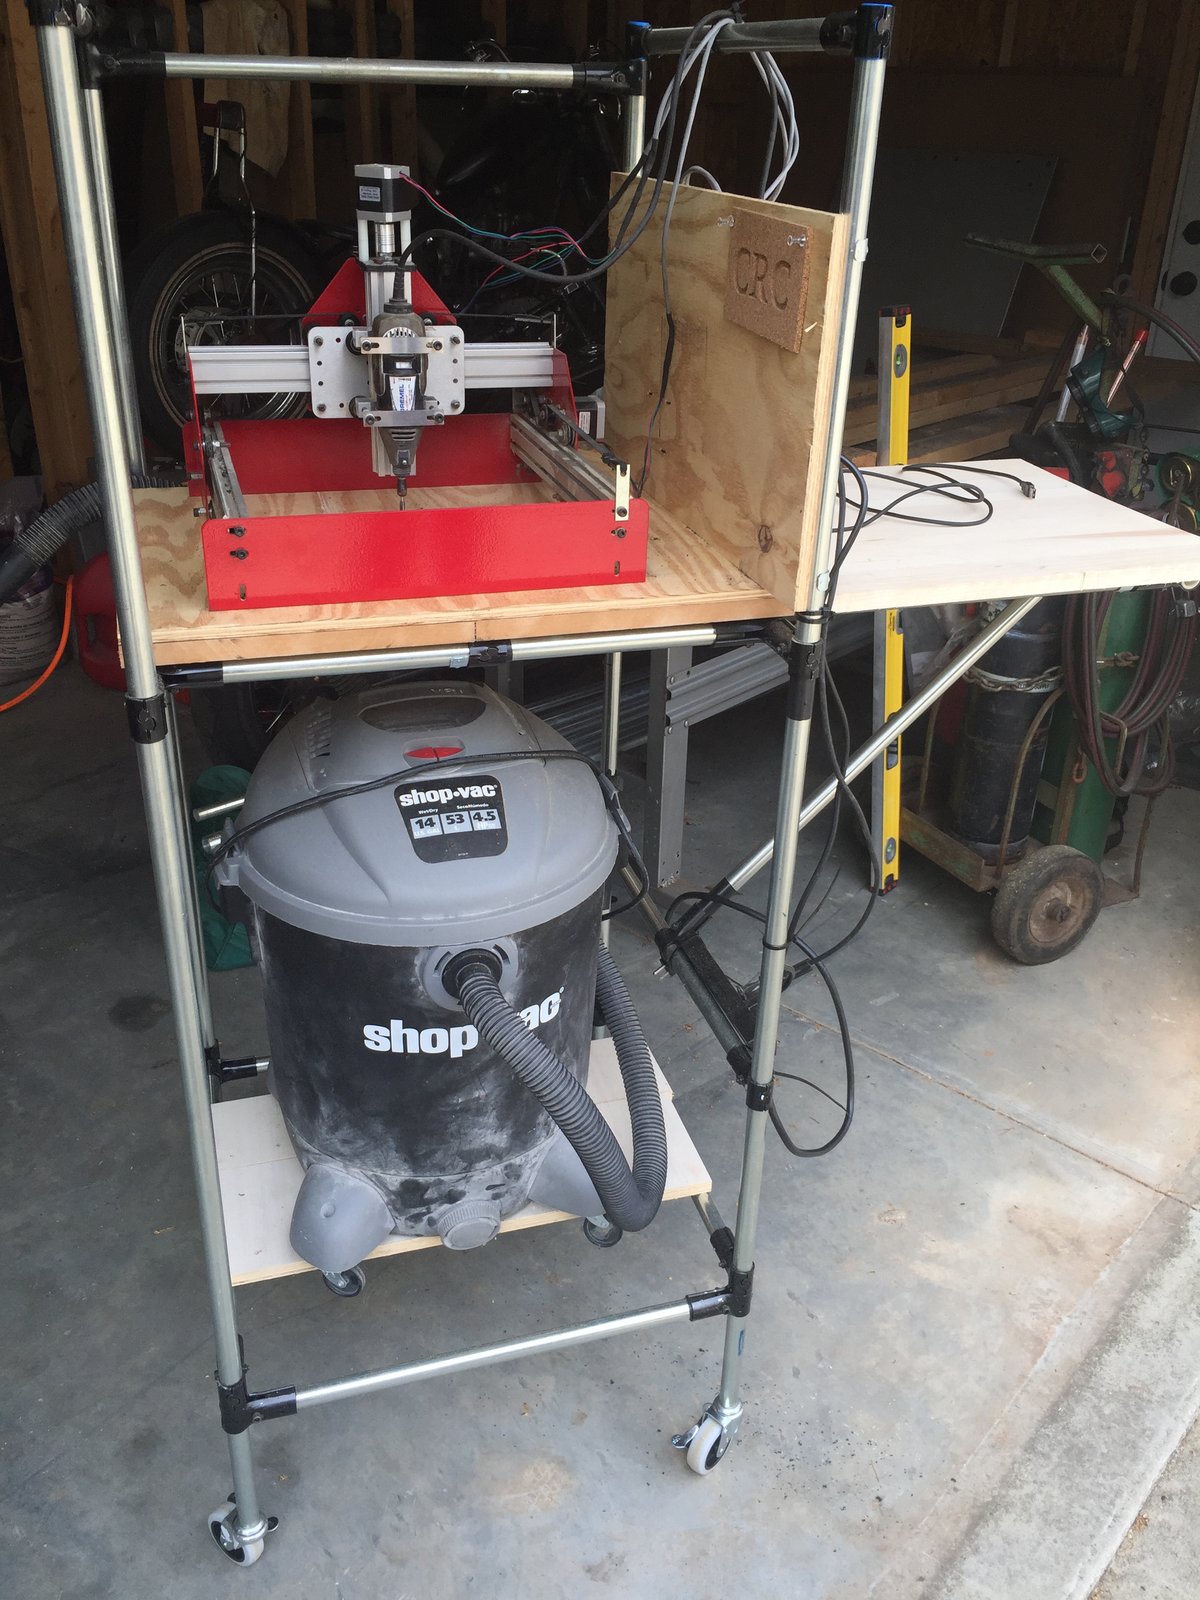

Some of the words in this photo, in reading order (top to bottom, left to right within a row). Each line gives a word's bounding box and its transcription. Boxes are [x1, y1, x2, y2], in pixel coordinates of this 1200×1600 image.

[736, 247, 791, 310] CRC
[446, 813, 465, 825] 53
[472, 811, 496, 822] 4.5
[415, 817, 436, 830] 14
